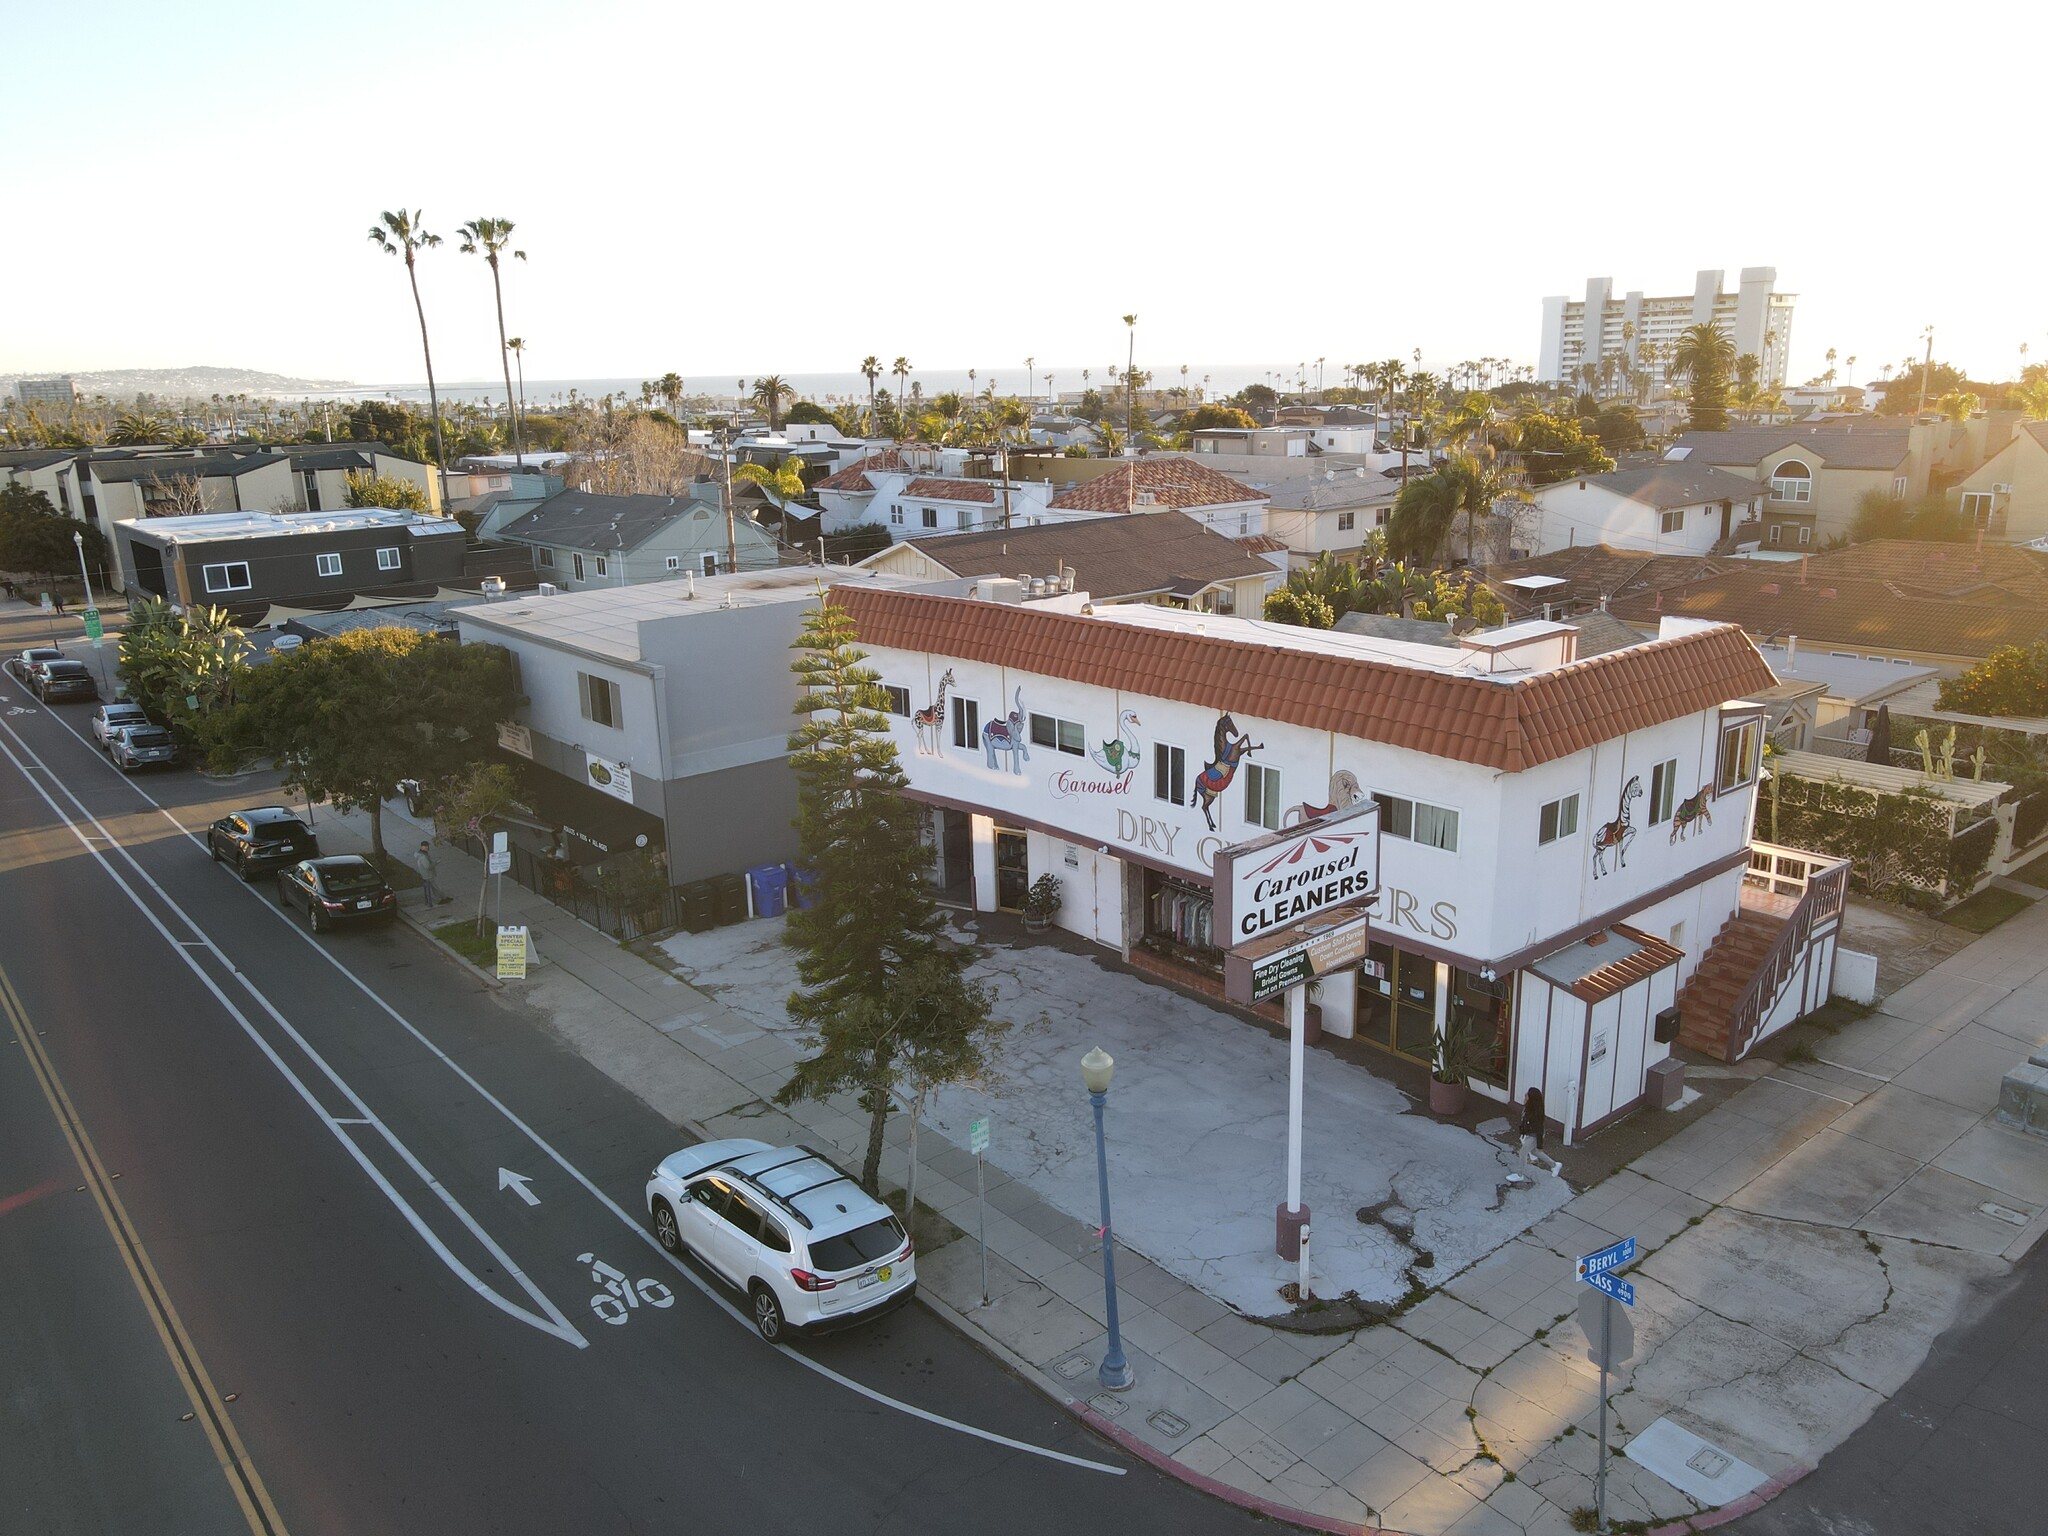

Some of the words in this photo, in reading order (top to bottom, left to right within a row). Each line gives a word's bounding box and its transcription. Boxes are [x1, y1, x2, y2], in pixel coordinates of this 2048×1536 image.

[1050, 770, 1134, 799] Carousel
[1116, 808, 1182, 857] DRY
[1254, 846, 1359, 902] Carousel
[1241, 870, 1369, 935] CLEANERS
[1310, 943, 1331, 956] Custom
[1331, 936, 1345, 949] Shirt
[1345, 928, 1365, 943] Service
[1320, 951, 1333, 962] Down
[1334, 940, 1361, 955] Comforters
[1254, 968, 1267, 980] Fine
[1268, 963, 1280, 975] Dry
[1280, 953, 1304, 969] Cleaning
[1326, 951, 1355, 968] Households
[1254, 988, 1270, 999] Plant
[1278, 972, 1304, 989] Premises
[1261, 972, 1278, 987] Bridal
[1278, 966, 1298, 978] Gowns
[1589, 1252, 1617, 1273] BERYL
[1621, 1282, 1628, 1290] ST
